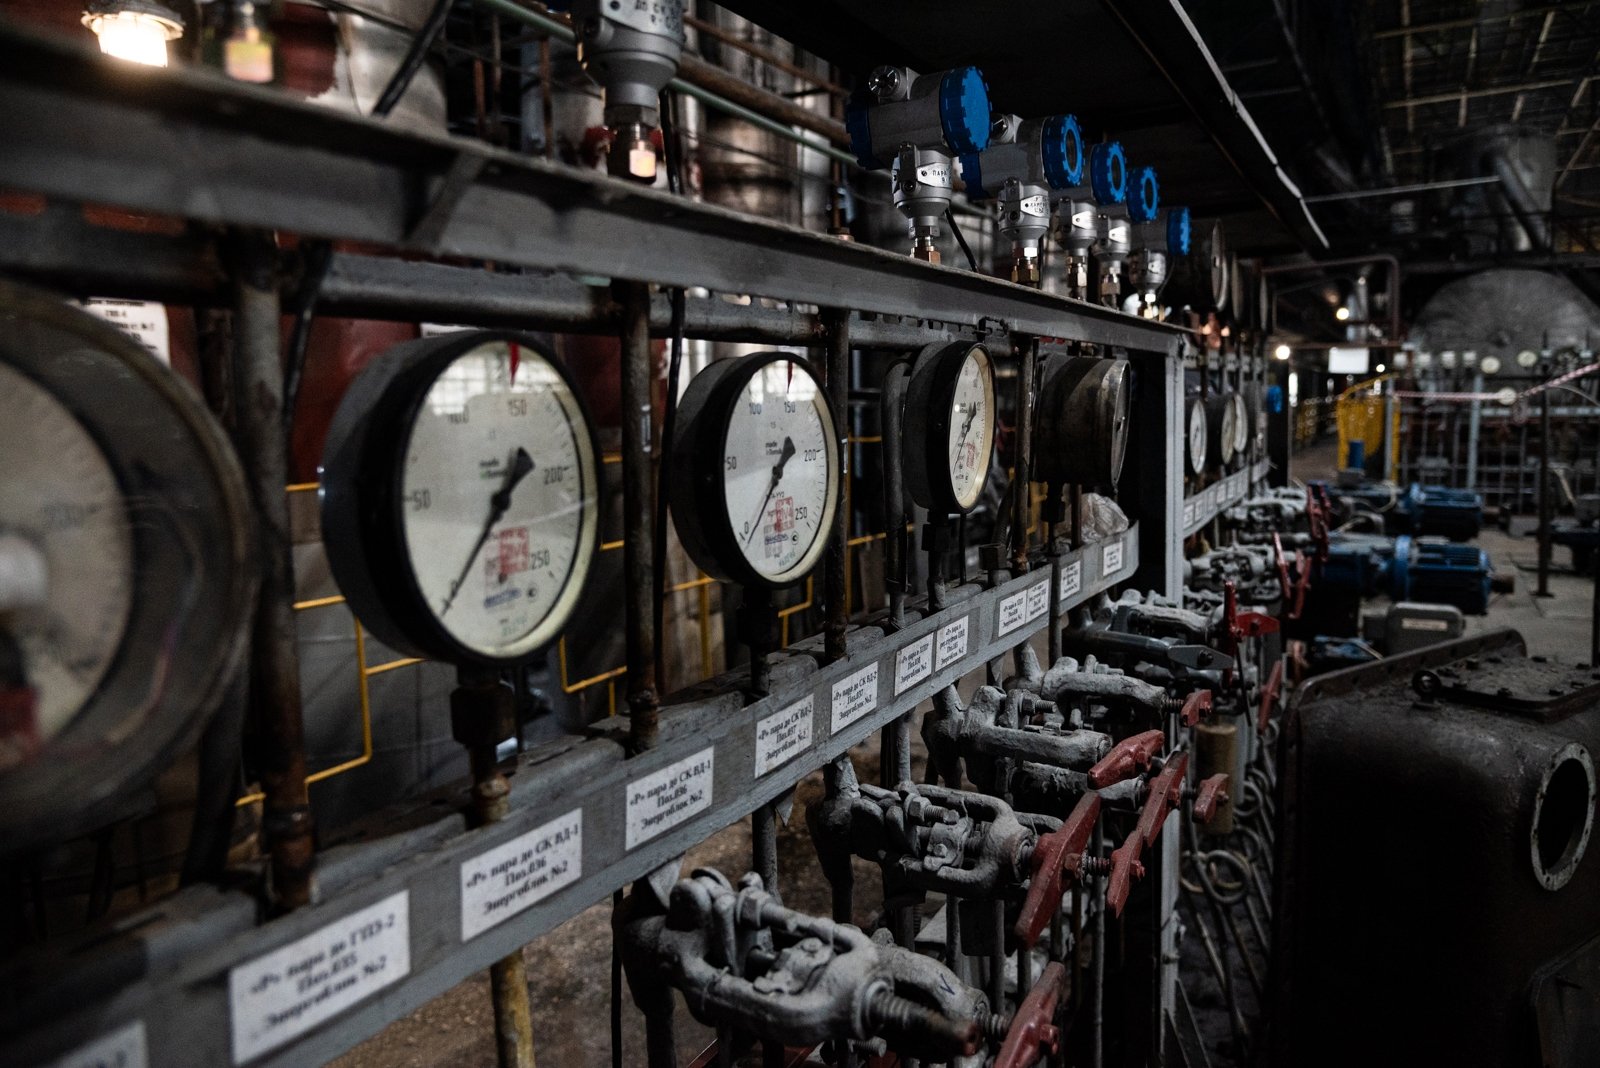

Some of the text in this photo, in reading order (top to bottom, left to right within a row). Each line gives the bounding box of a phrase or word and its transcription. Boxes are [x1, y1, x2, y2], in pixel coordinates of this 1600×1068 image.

[784, 401, 796, 413] 150
[726, 456, 737, 470] 50
[804, 449, 817, 461] 200
[544, 467, 563, 485] 200
[795, 506, 808, 520] 250
[744, 521, 749, 535] 0
[531, 550, 550, 571] 250
[859, 677, 866, 686] СК
[770, 722, 783, 734] пара
[784, 718, 790, 728] до
[791, 712, 799, 722] СК
[766, 730, 806, 761] Энергоблок №2
[647, 783, 667, 798] пара
[669, 778, 677, 788] до
[679, 770, 692, 782] СК
[693, 760, 710, 776] ВД-1
[642, 790, 702, 829] Энергоблок №2
[491, 857, 517, 876] пара
[521, 850, 532, 863] до
[535, 838, 552, 853] СК
[555, 824, 578, 844] ВД-1
[485, 861, 567, 912] Энергоблок №2
[363, 956, 385, 975] №2
